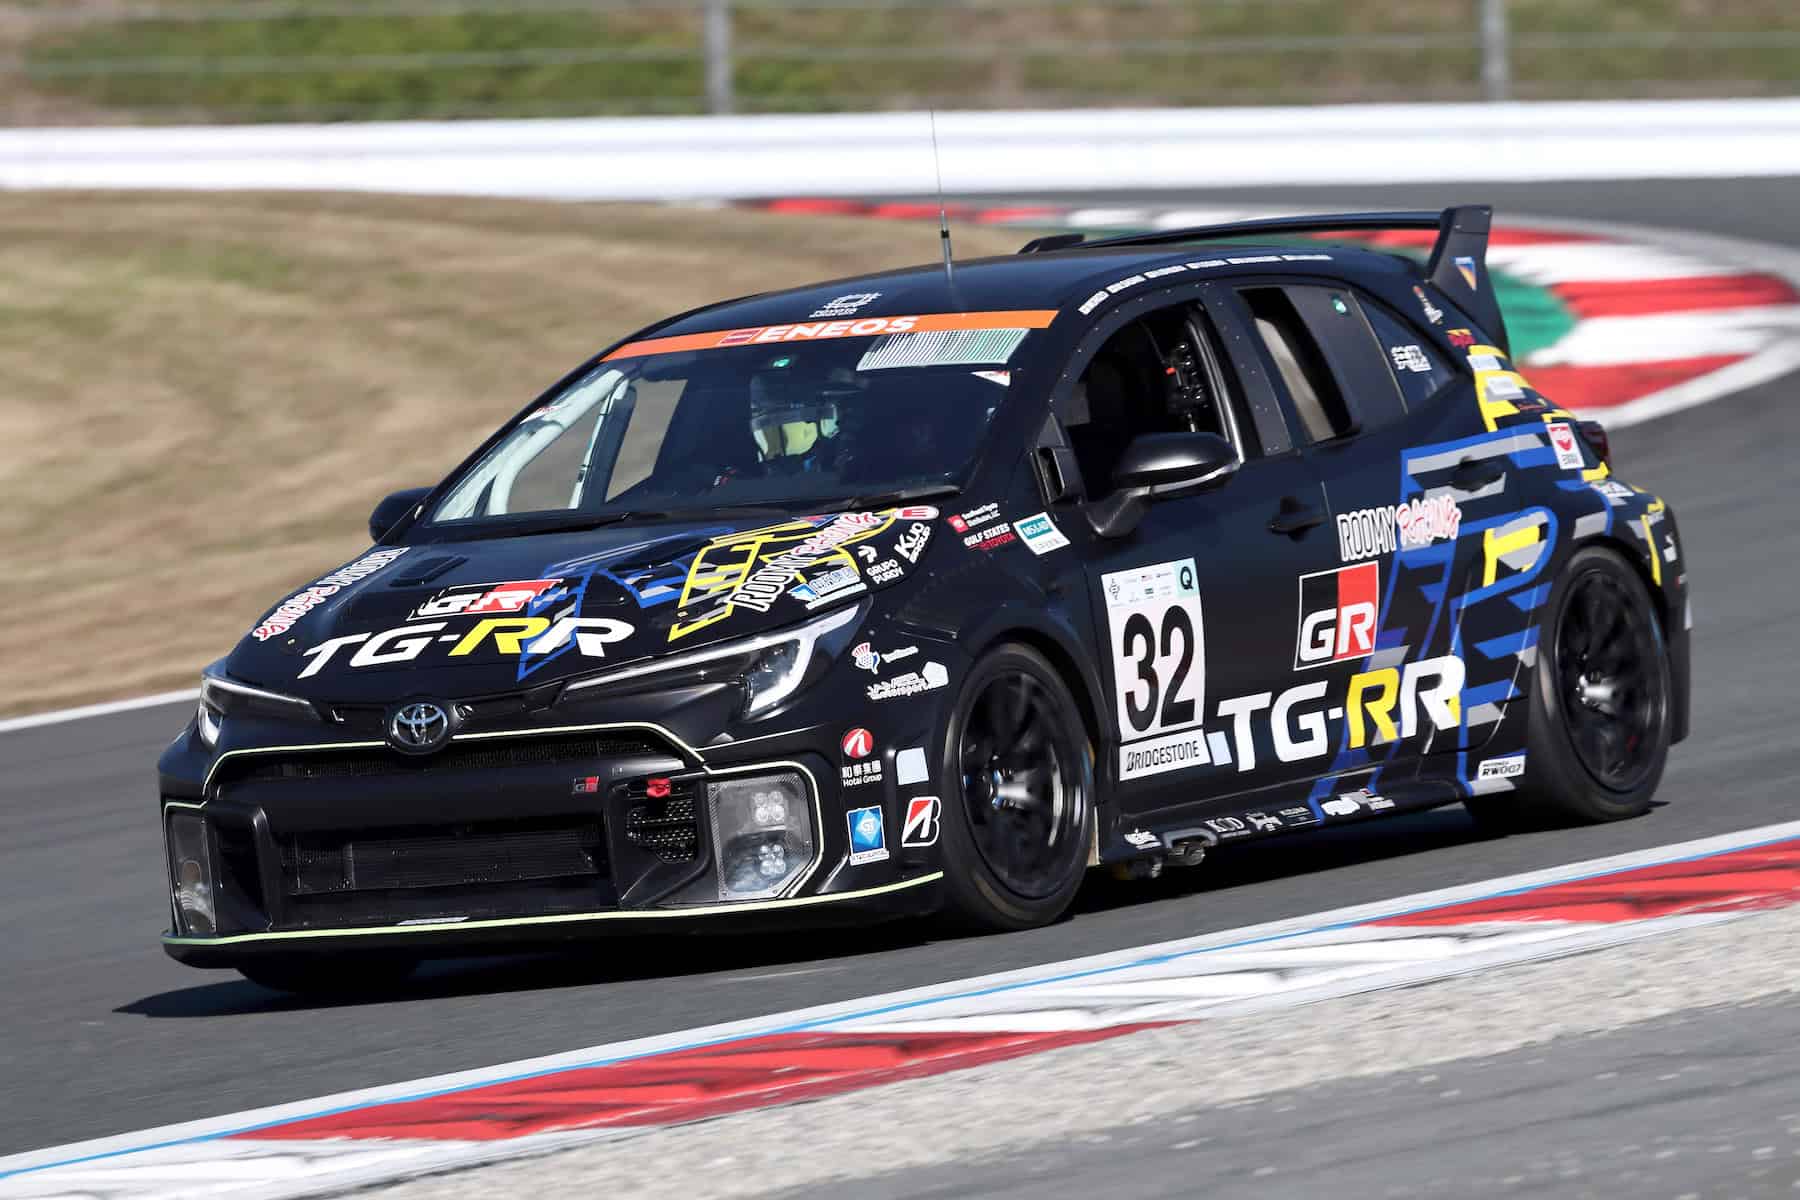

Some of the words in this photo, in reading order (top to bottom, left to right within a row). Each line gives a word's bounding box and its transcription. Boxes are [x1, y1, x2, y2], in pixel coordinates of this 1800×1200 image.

[756, 317, 919, 342] ENEOS
[963, 532, 983, 546] GULF
[983, 522, 1010, 540] STATES
[1336, 505, 1397, 562] ROOMY
[867, 559, 899, 577] GRUPO
[873, 566, 904, 584] PURDY
[1180, 566, 1194, 590] Q
[416, 589, 540, 616] GR
[1299, 601, 1376, 662] GR
[297, 616, 636, 680] TG-RR
[1123, 605, 1196, 732] 32
[1216, 655, 1466, 773] TG-RR
[1126, 740, 1201, 772] BRIDGESTONE
[863, 773, 883, 784] Group
